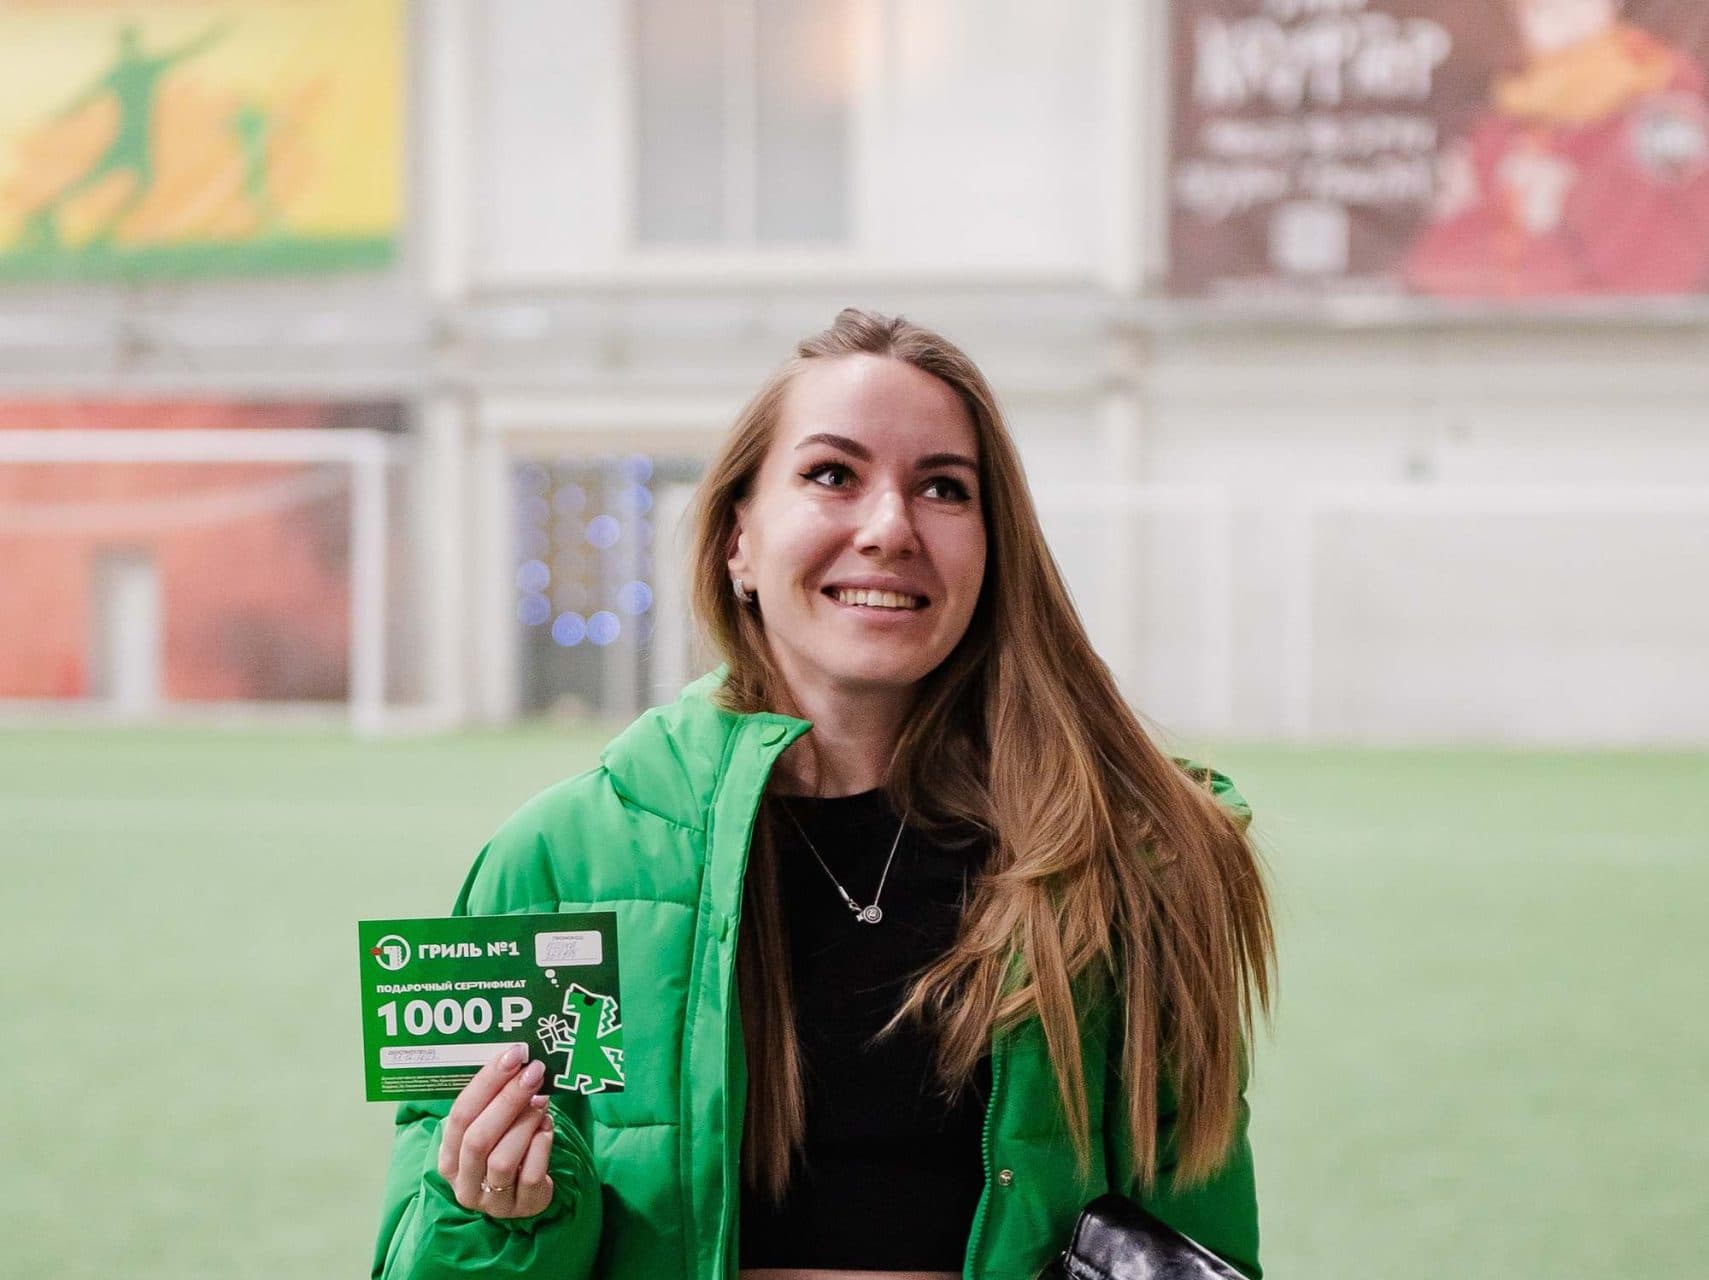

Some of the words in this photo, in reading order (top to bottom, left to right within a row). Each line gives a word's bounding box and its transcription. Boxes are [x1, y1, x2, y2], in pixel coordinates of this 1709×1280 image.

[418, 942, 483, 959] ГРИЛЬ
[487, 941, 520, 957] №1
[377, 981, 452, 994] ПОДАРОЧНЫЙ
[454, 979, 527, 991] СЕРТИФИКАТ
